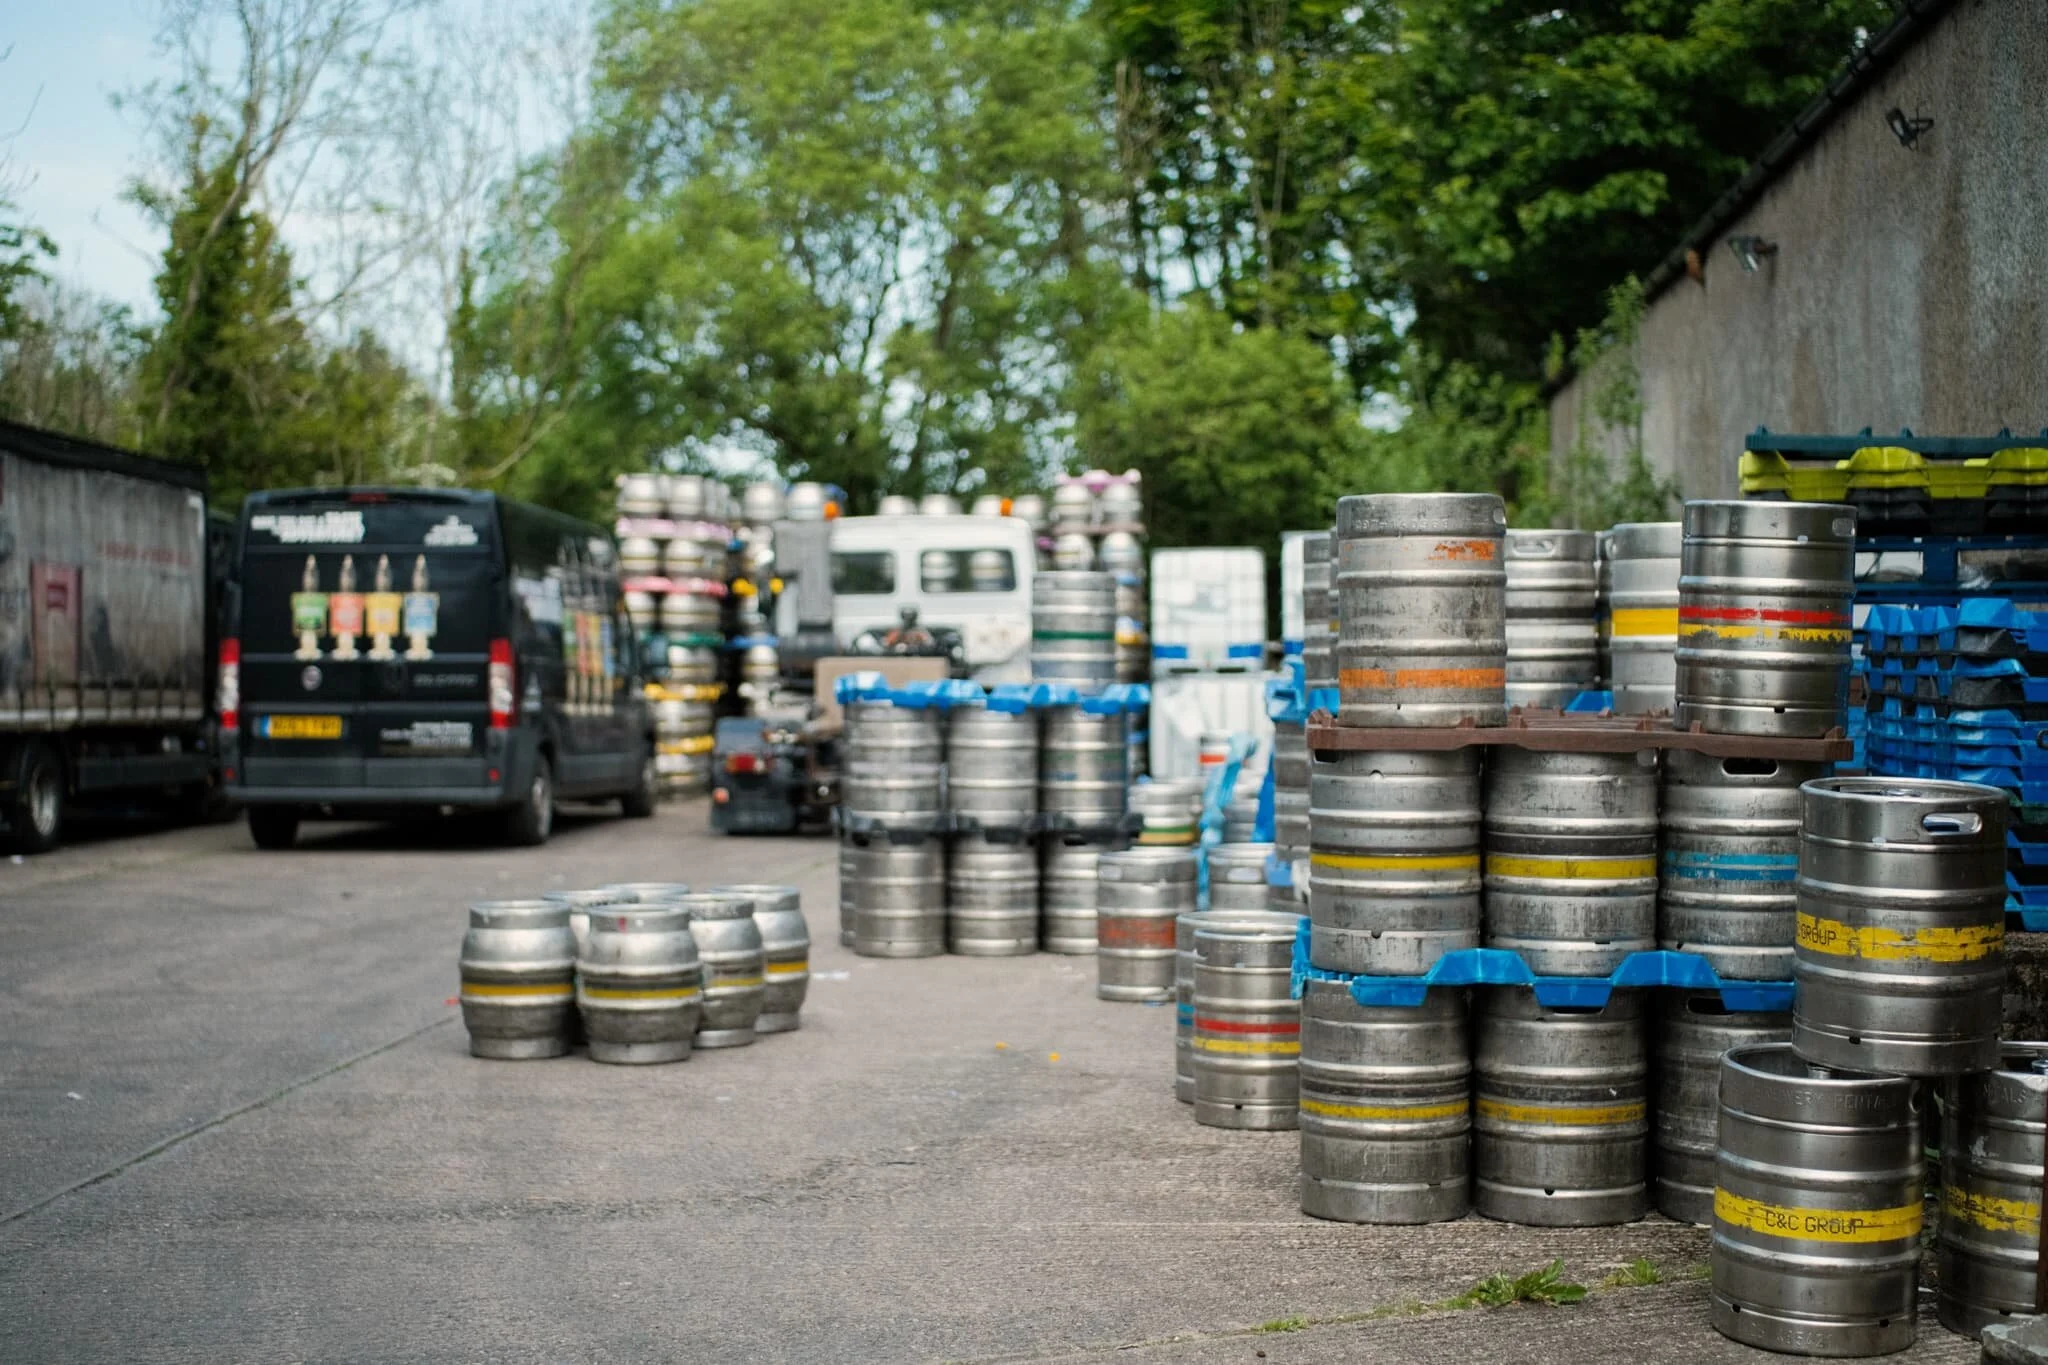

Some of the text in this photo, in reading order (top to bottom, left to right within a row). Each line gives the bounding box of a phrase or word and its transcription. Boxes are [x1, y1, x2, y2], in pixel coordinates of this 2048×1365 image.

[1801, 923, 1836, 946] GROUP
[1765, 1209, 1863, 1235] C&C GROUP
